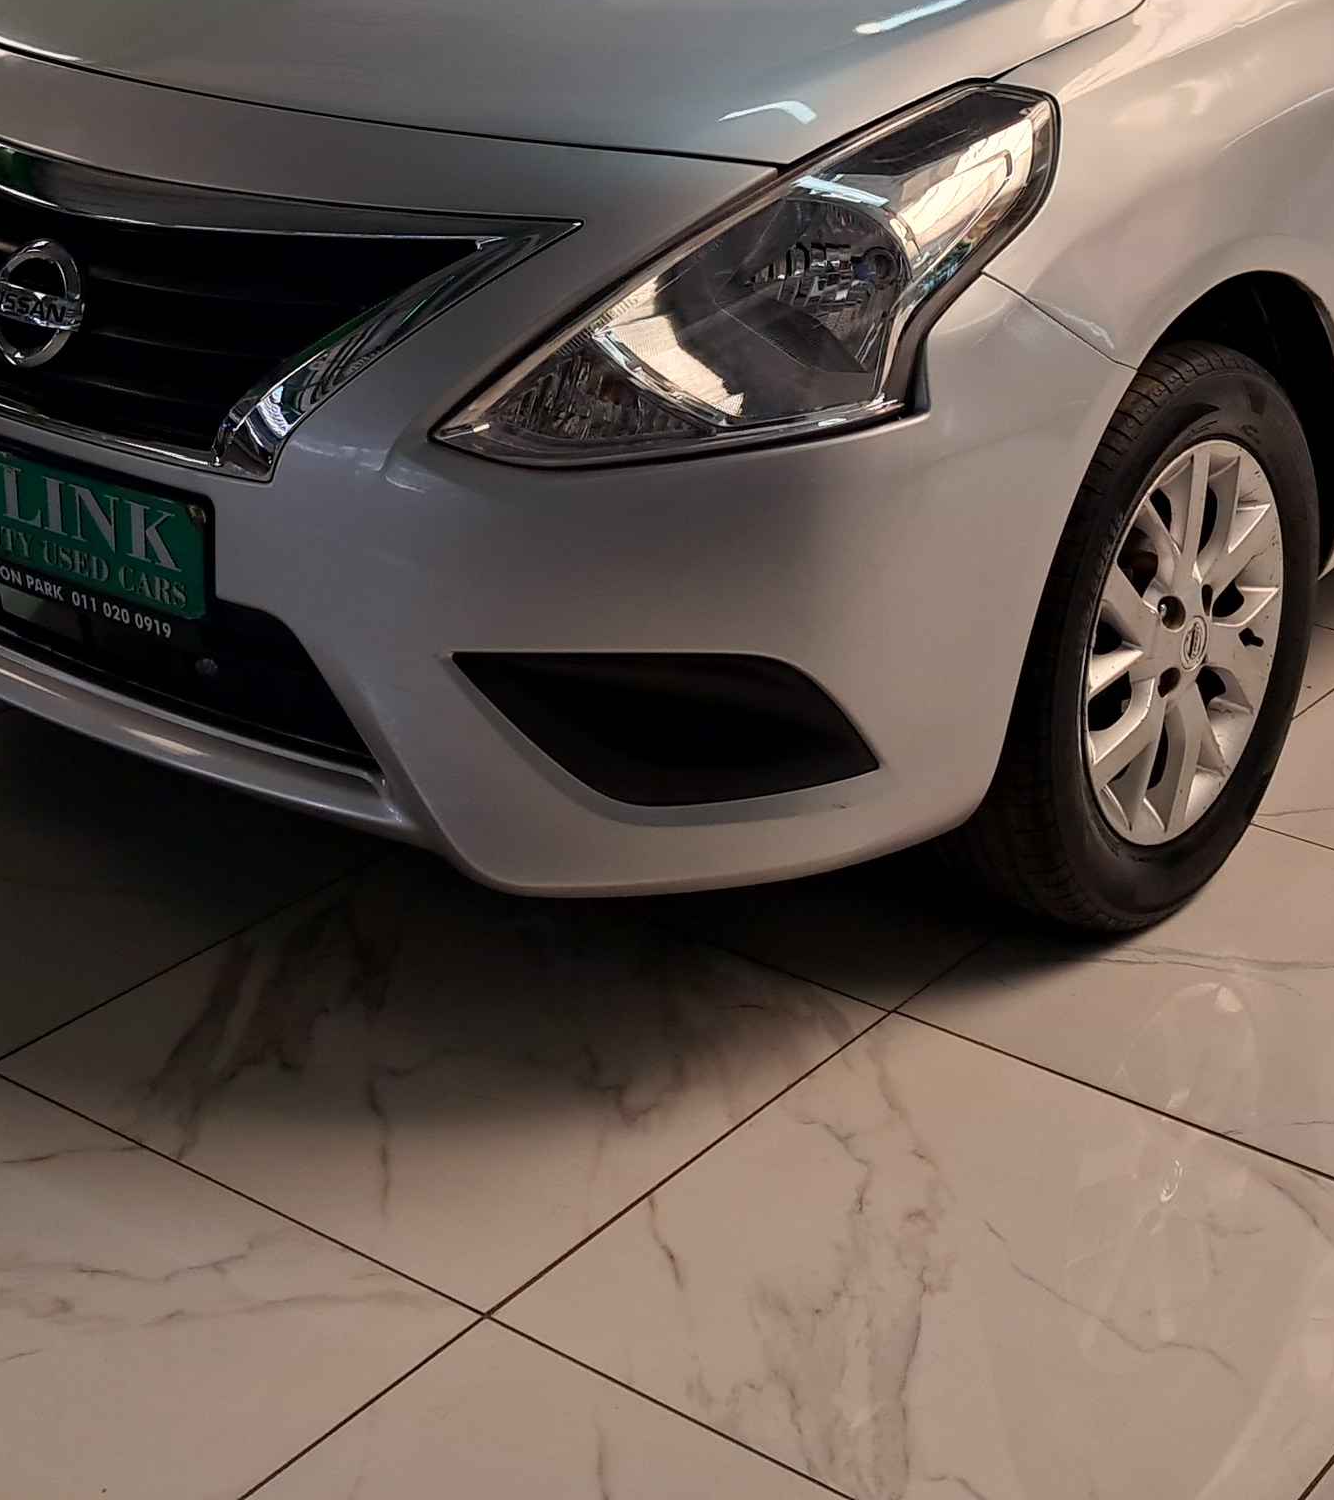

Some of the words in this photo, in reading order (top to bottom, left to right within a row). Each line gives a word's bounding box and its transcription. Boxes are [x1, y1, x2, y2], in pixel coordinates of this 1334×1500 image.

[0, 462, 182, 573] LINK
[26, 574, 63, 601] PARK
[72, 591, 97, 614] 011
[103, 600, 131, 625] 020
[135, 611, 171, 639] 0919
[43, 539, 110, 583] USED
[118, 565, 187, 608] CARS
